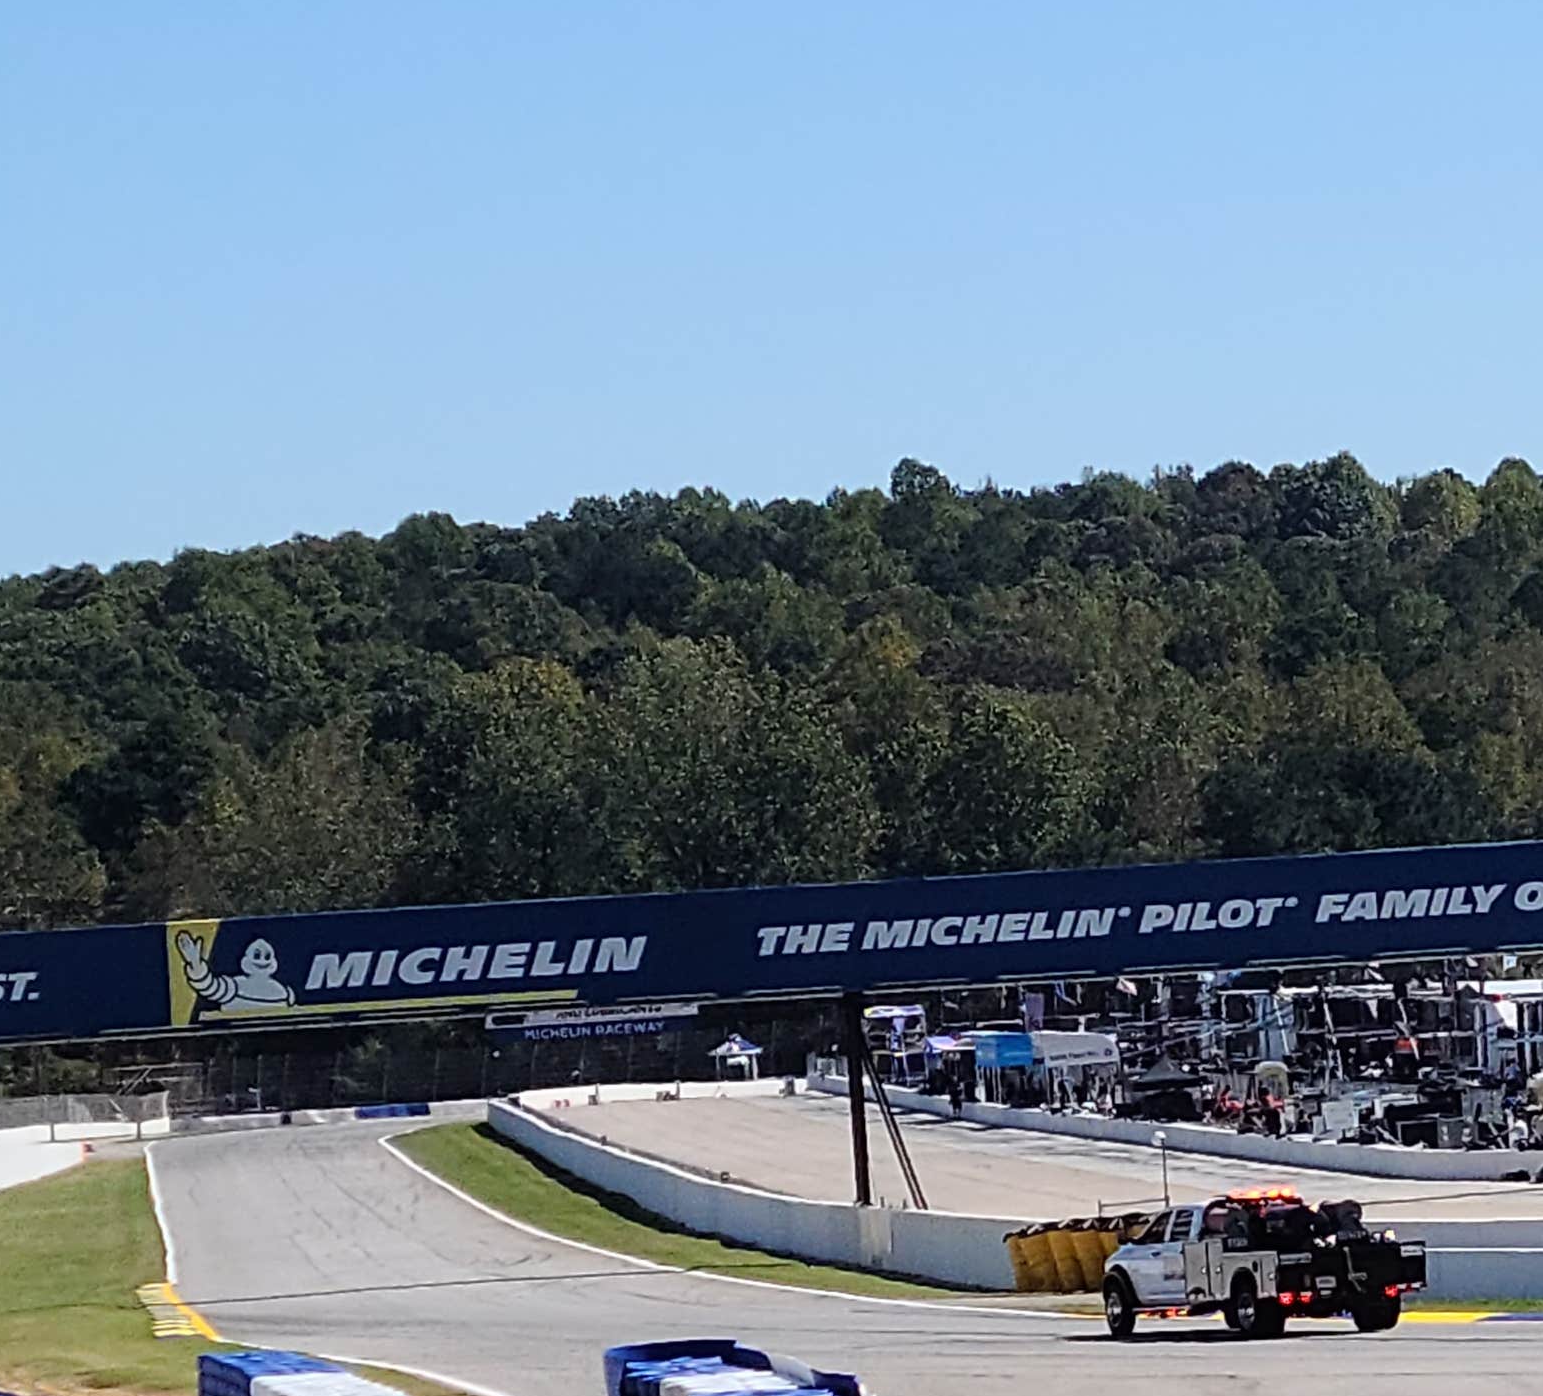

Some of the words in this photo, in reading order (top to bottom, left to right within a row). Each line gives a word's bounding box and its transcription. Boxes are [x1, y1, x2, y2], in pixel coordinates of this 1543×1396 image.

[757, 920, 856, 956] THE
[860, 906, 1118, 951] MICHELIN
[1138, 897, 1285, 934] PILOT
[1314, 883, 1509, 923] FAMILY
[305, 936, 648, 991] MICHELIN
[524, 1025, 592, 1040] MICHELIN
[595, 1021, 665, 1036] RACEWAY
